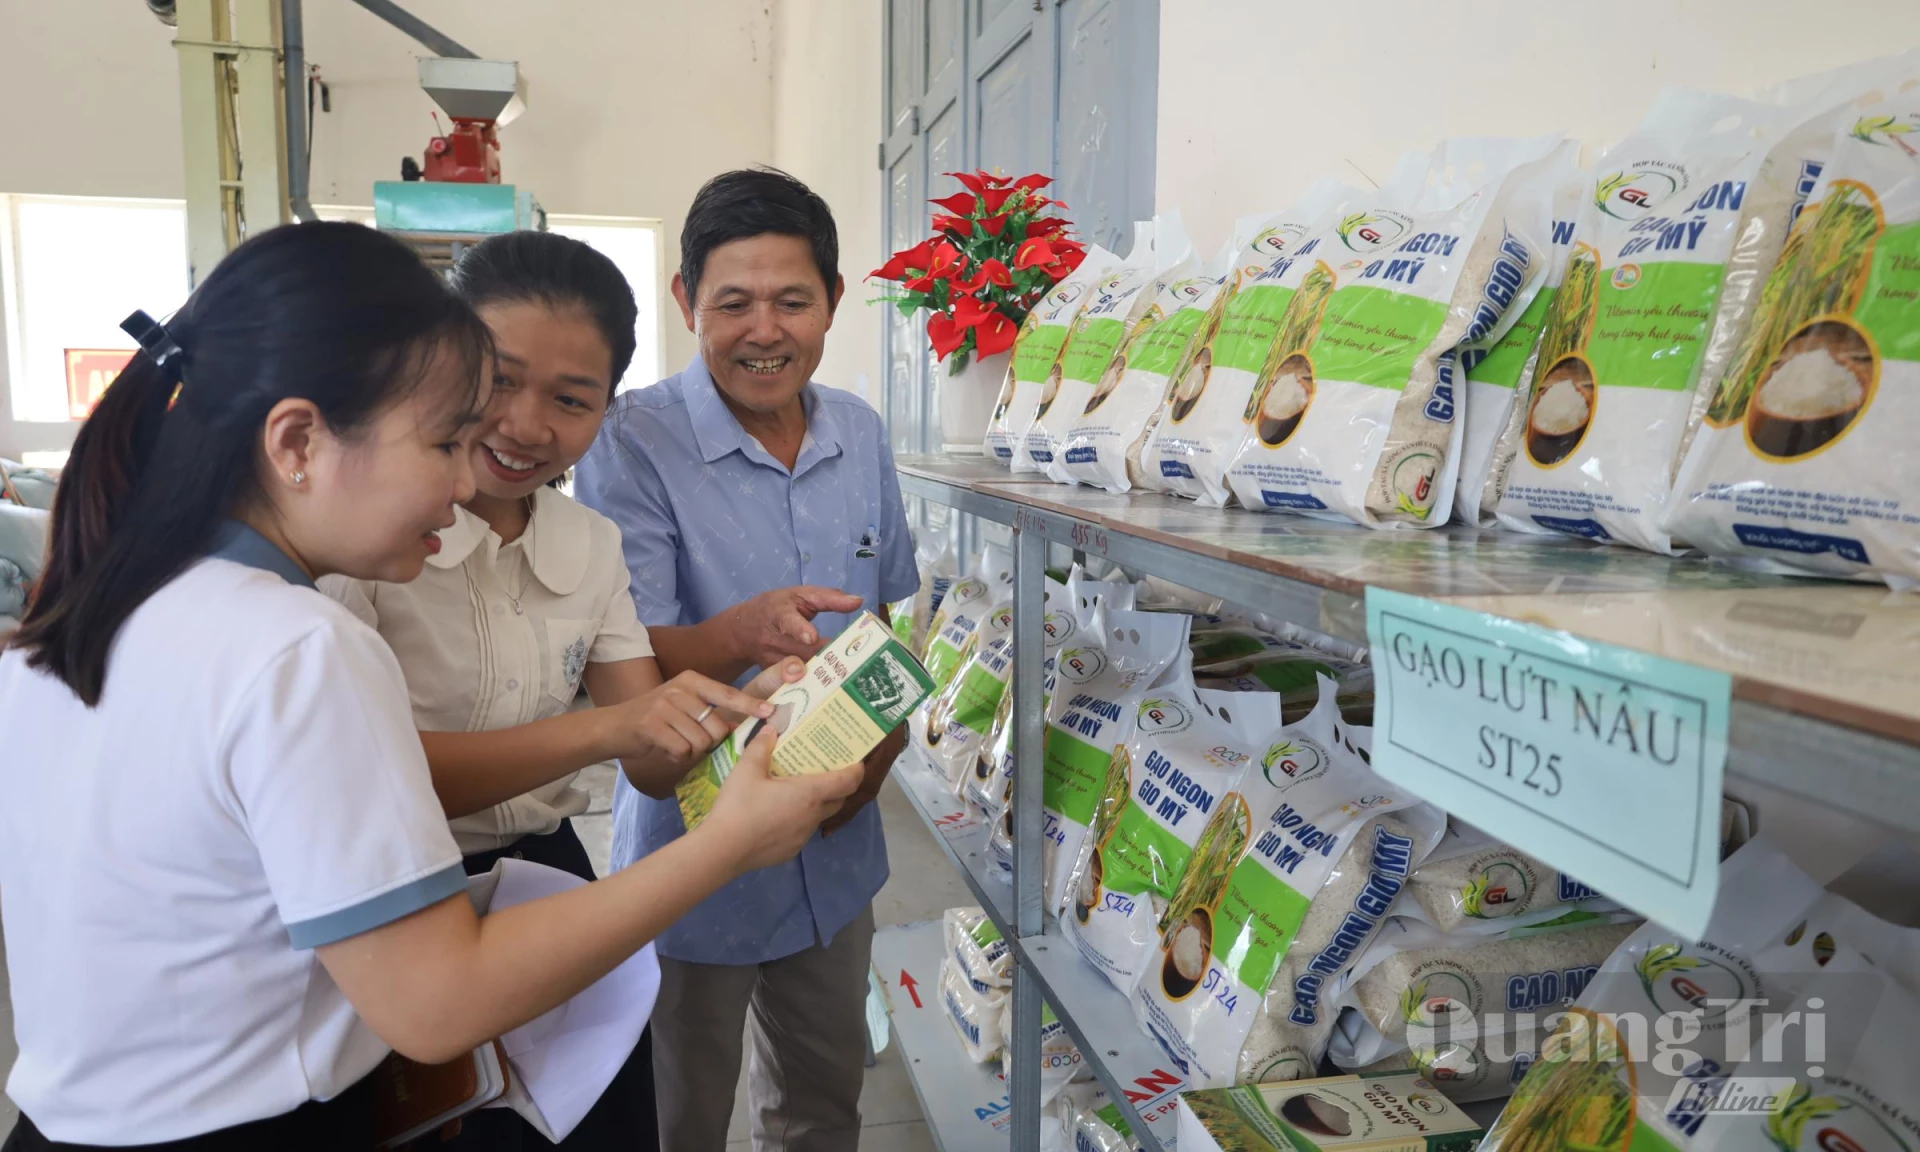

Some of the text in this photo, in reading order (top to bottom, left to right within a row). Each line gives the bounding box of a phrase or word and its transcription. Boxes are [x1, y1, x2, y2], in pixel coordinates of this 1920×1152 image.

[1398, 233, 1459, 256] GON
[1655, 215, 1707, 251] MỸ
[1382, 257, 1425, 284] MỸ
[1069, 658, 1085, 676] GL
[1393, 631, 1686, 767] GẠO LỨT NÂU
[1078, 716, 1103, 739] MỸ
[1149, 709, 1165, 725] GL
[1477, 725, 1564, 797] ST25
[1144, 750, 1214, 815] GẠO NGON
[1138, 779, 1188, 827] GIO MỸ
[1255, 830, 1282, 858] GIO
[1371, 824, 1413, 877] MỸ
[1355, 871, 1403, 919] GIO
[1484, 886, 1518, 905] GL
[1308, 912, 1375, 975] NGON
[1507, 972, 1559, 1012] GẠO
[1363, 1092, 1386, 1109] GIO
[1393, 1104, 1429, 1132] NGON
